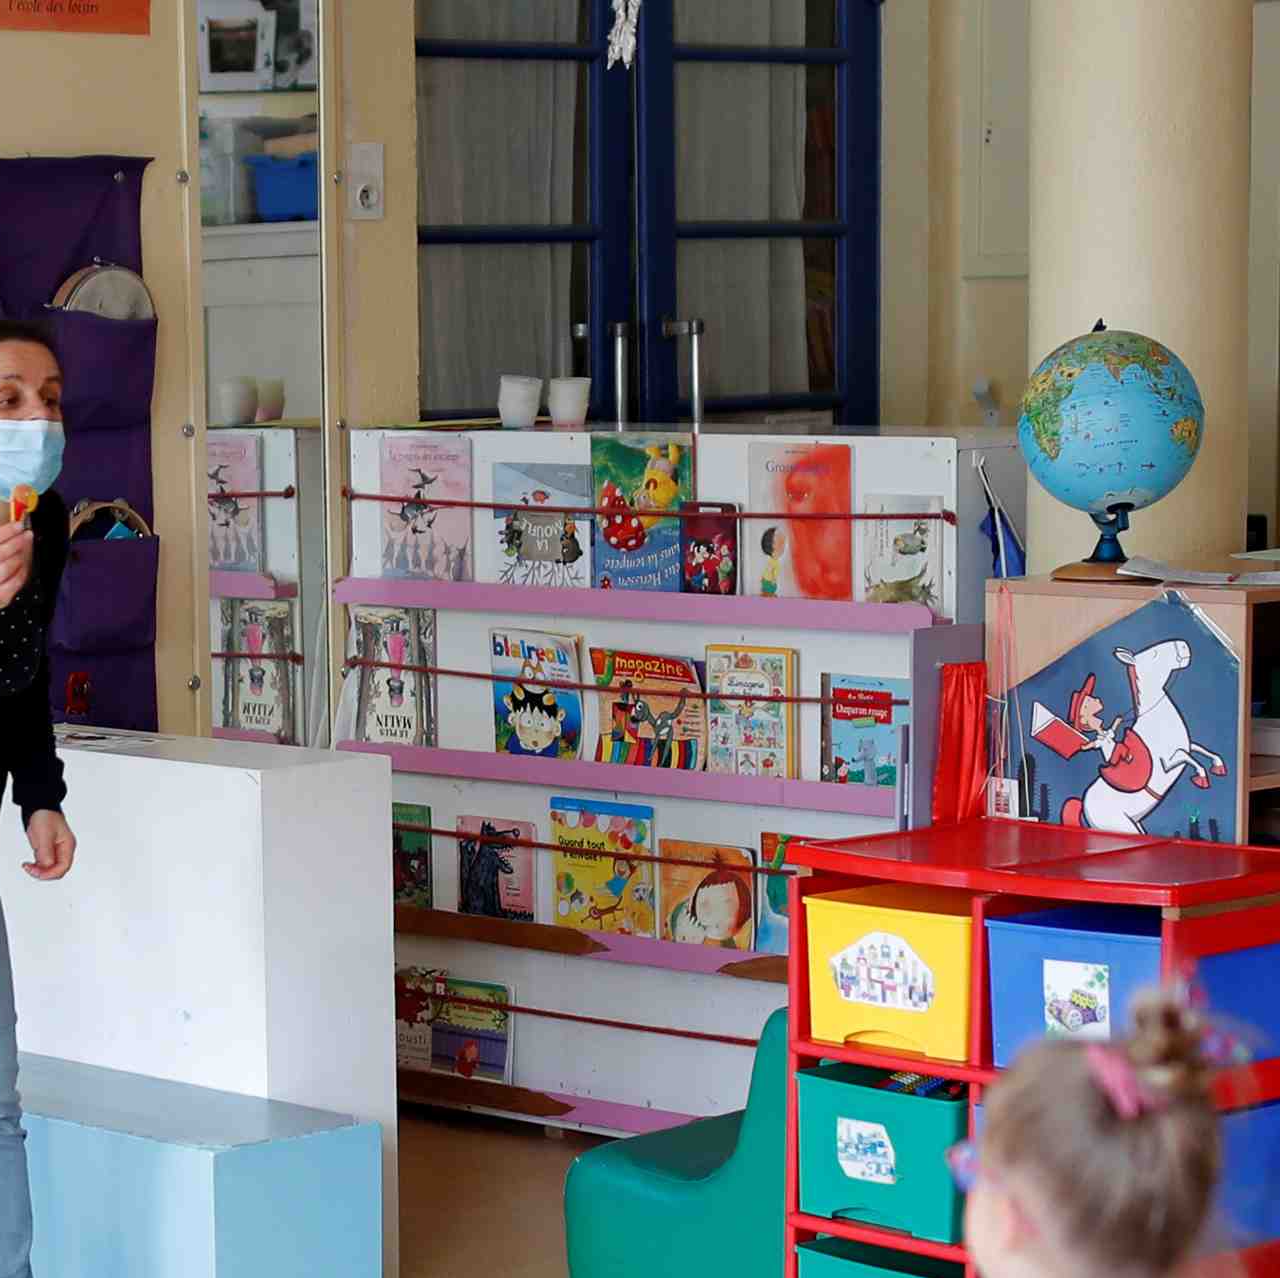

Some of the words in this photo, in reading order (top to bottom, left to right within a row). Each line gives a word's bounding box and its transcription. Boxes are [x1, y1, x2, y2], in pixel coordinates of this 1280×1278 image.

[535, 539, 549, 553] LA
[614, 655, 685, 683] magazine
[375, 714, 413, 729] MALIN
